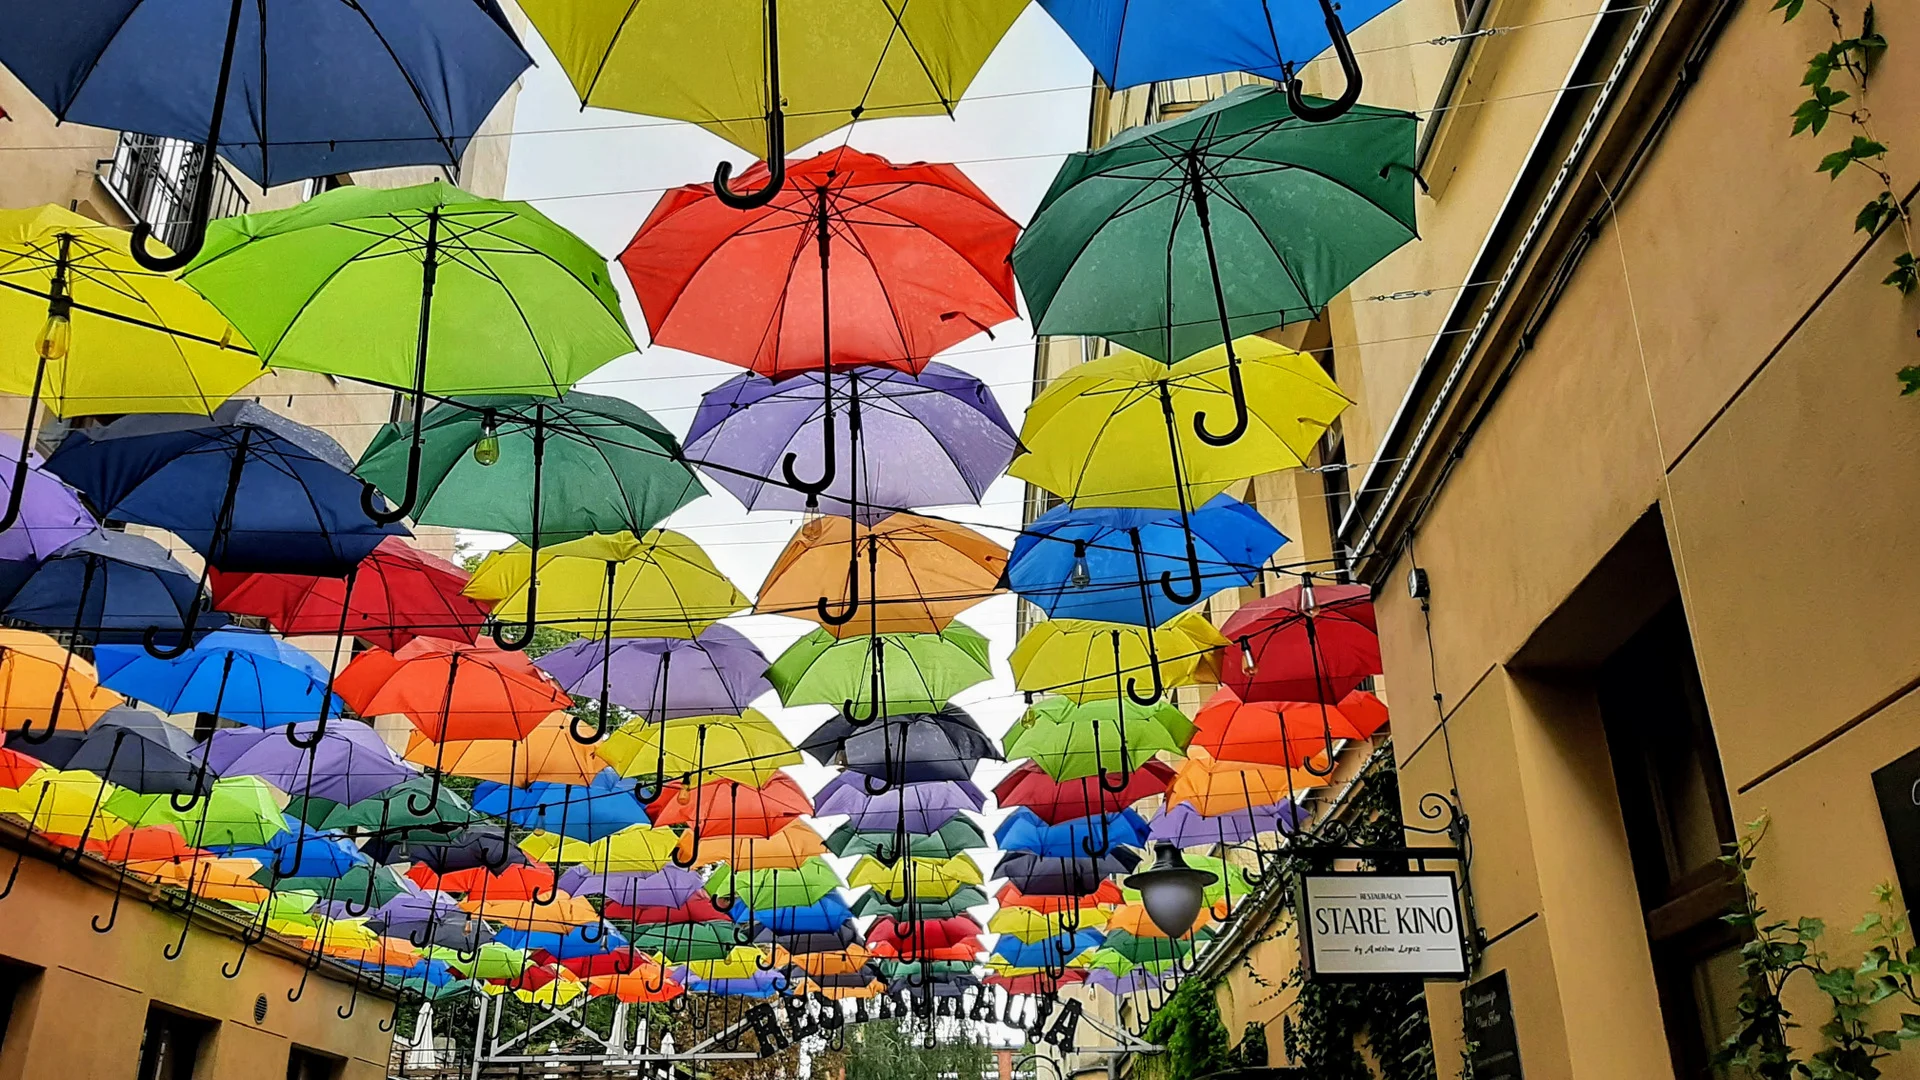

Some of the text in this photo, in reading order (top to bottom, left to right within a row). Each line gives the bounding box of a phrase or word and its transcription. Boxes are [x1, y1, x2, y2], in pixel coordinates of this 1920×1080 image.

[1315, 906, 1453, 935] STARE KINO
[1354, 945, 1363, 955] by
